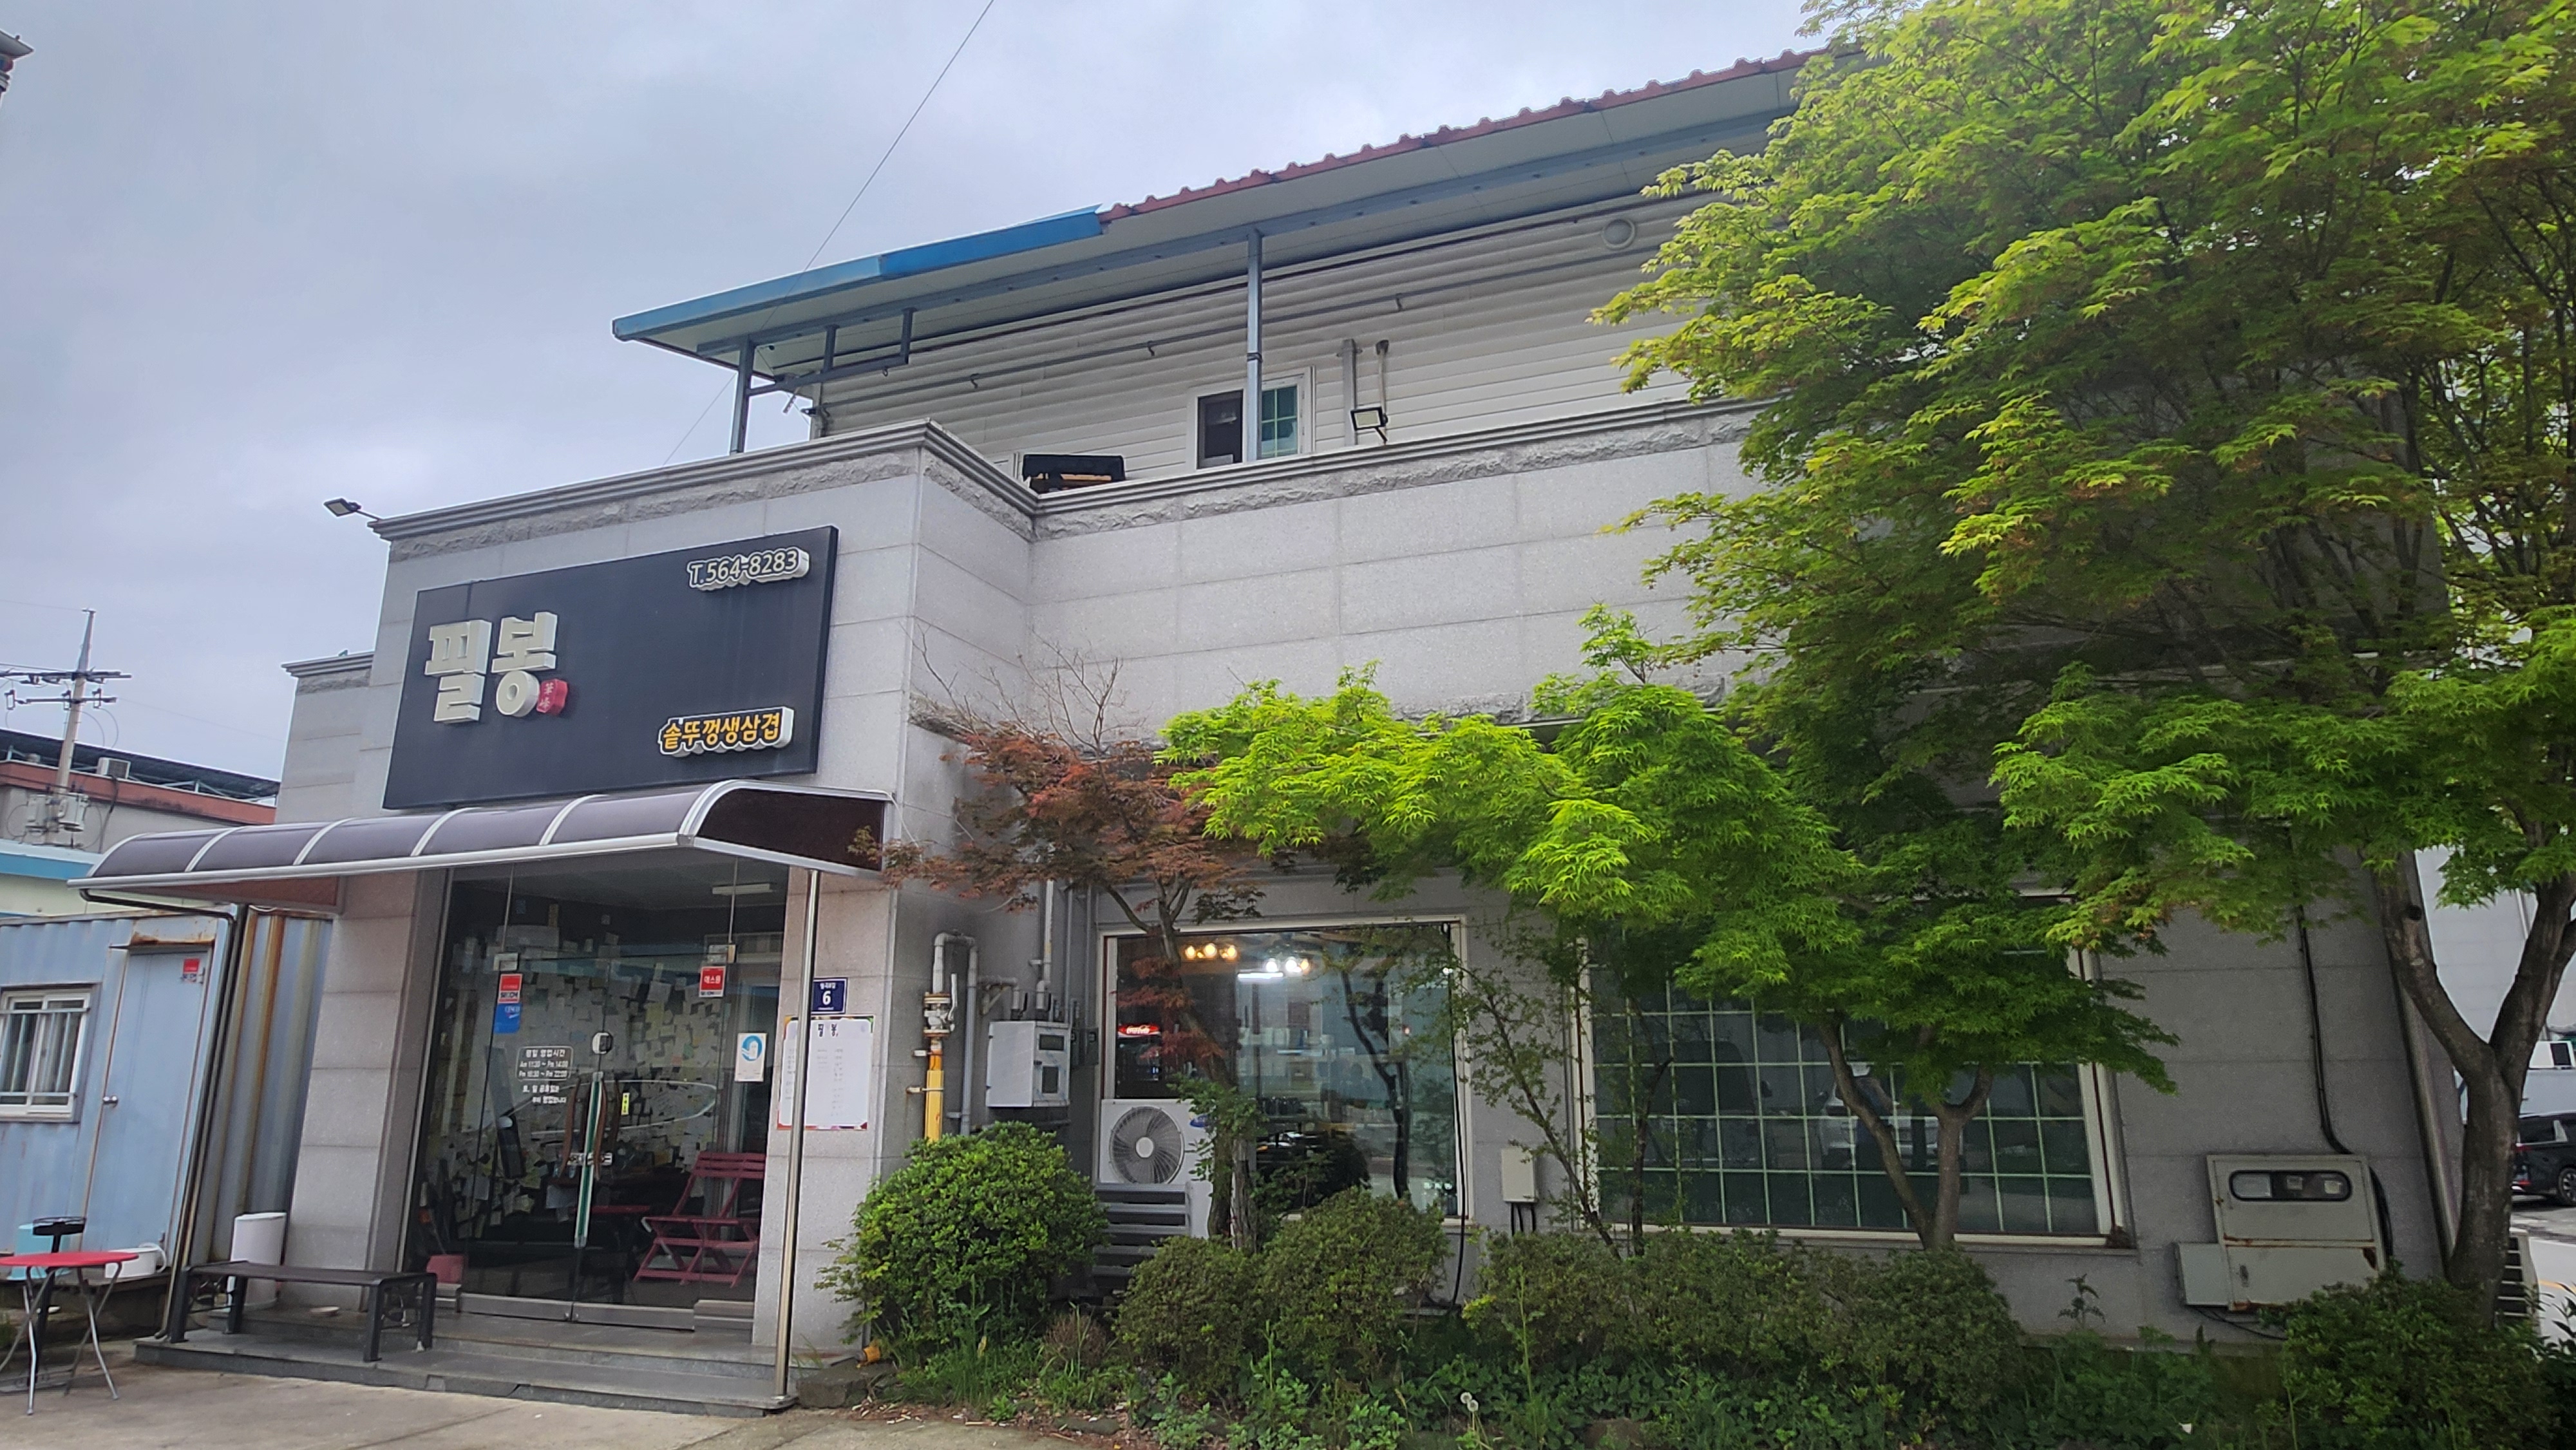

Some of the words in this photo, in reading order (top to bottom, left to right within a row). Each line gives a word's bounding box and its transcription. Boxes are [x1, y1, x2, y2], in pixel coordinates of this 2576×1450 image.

[690, 549, 799, 585] T.564-8283
[424, 612, 557, 722] 필봉
[663, 711, 781, 750] 솥뚜껑생삼겹
[822, 990, 831, 1005] 6
